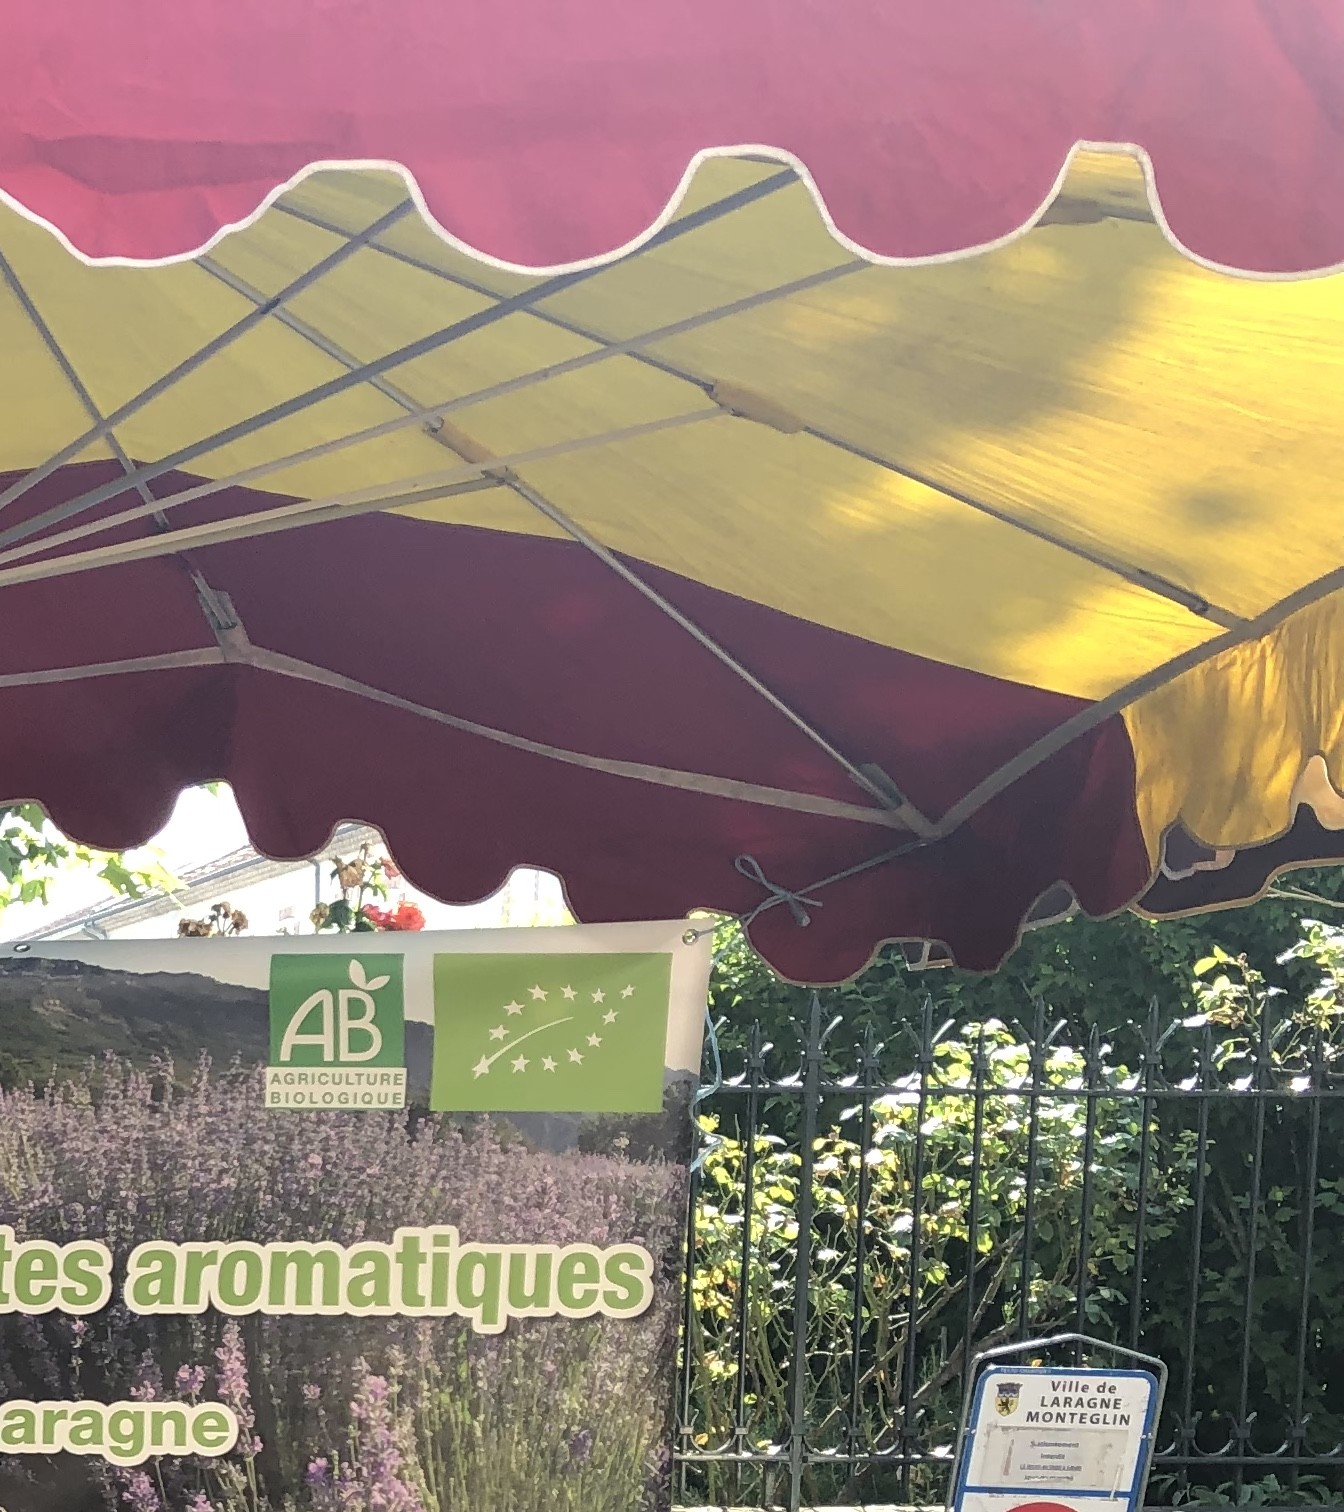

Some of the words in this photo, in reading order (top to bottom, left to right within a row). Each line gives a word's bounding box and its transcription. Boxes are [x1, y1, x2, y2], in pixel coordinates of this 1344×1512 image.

[280, 989, 384, 1063] AB
[271, 1072, 403, 1087] AGRICULTURE
[271, 1090, 403, 1106] BIOLOGIQUE
[132, 1234, 647, 1326] aromatiques
[1051, 1381, 1090, 1394] Ville
[1097, 1381, 1117, 1394] de
[1040, 1396, 1123, 1411] LARAGNE
[1026, 1411, 1131, 1426] MONTEGLIN
